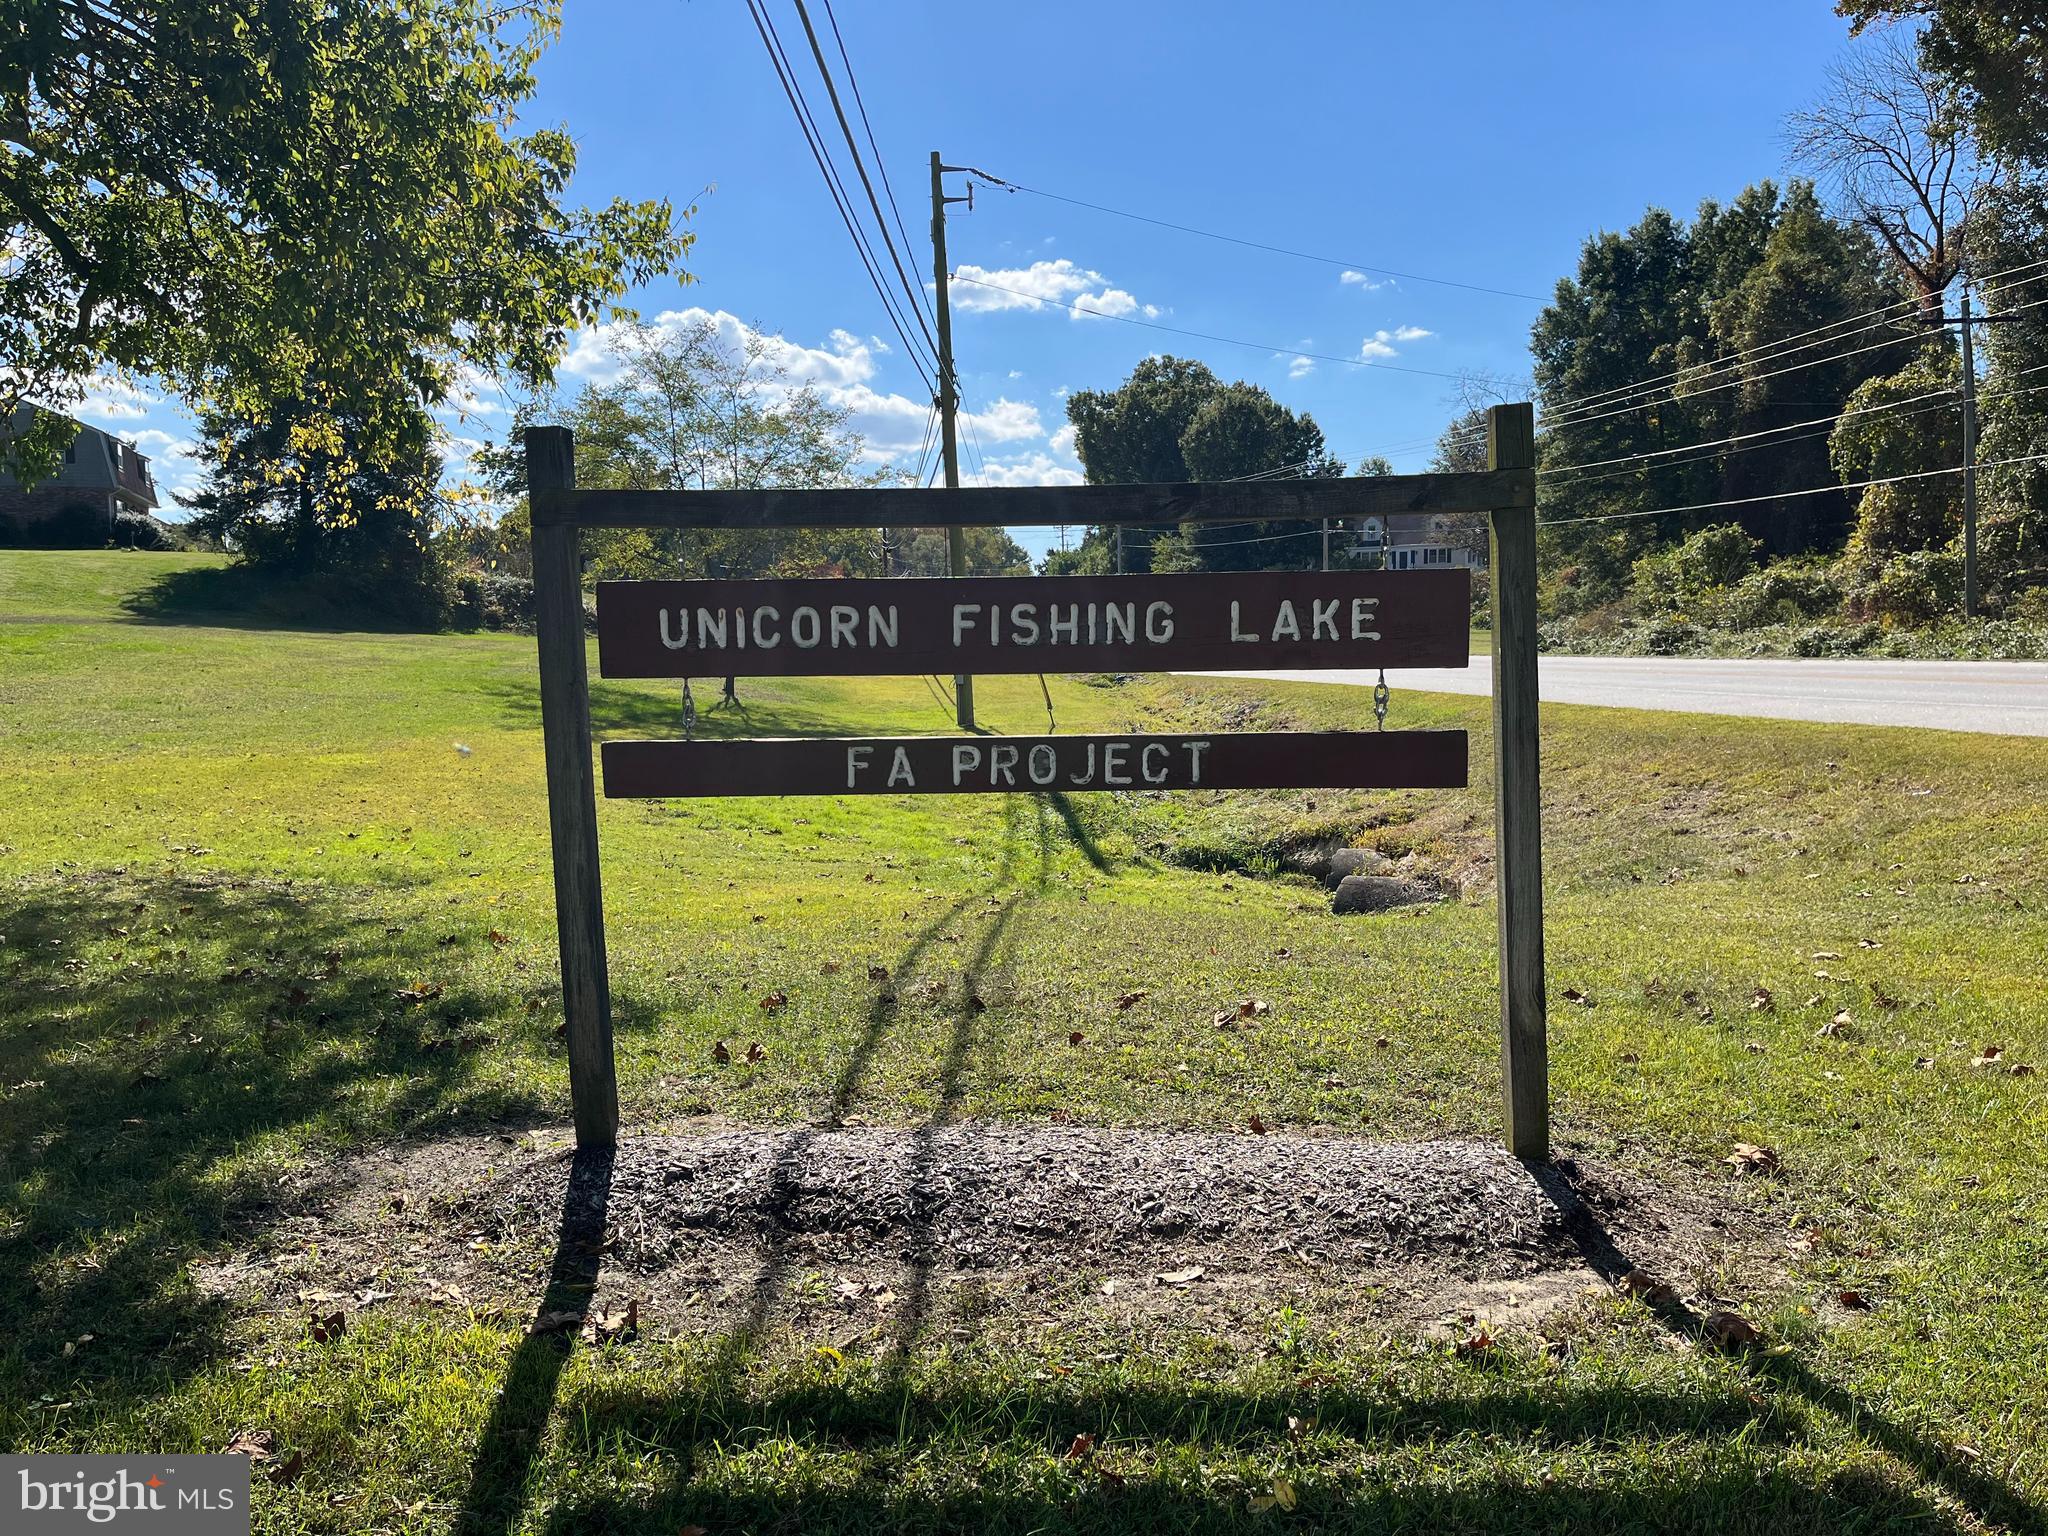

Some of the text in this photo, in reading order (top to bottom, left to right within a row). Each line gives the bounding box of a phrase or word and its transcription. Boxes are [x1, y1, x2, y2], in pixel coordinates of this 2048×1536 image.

[658, 598, 1382, 650] UNICORN FISHING LAKE
[846, 742, 1211, 789] FA PROJECT
